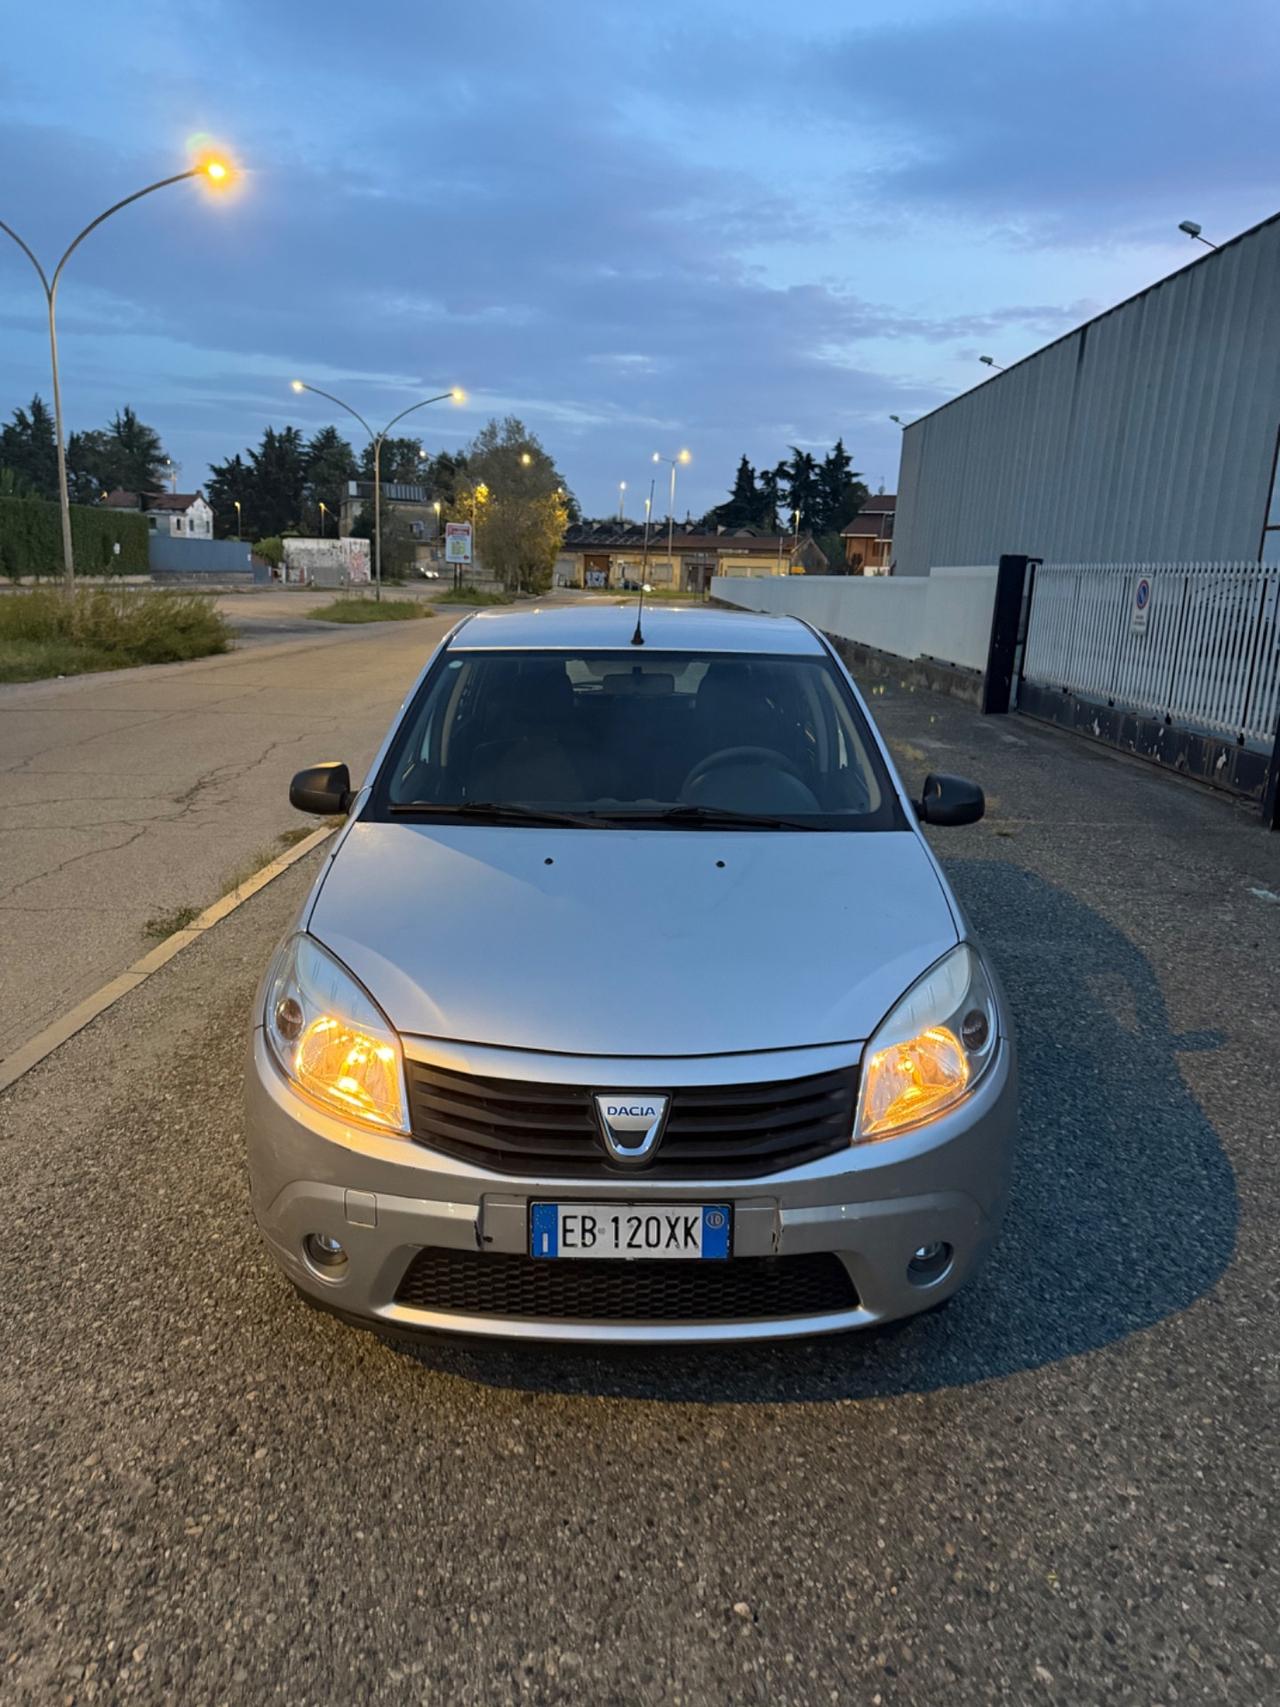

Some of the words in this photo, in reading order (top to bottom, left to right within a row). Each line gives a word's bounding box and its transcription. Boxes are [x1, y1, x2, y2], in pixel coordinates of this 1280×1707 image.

[607, 1106, 656, 1116] DACIA
[561, 1215, 597, 1248] EB
[610, 1215, 700, 1249] 120XK
